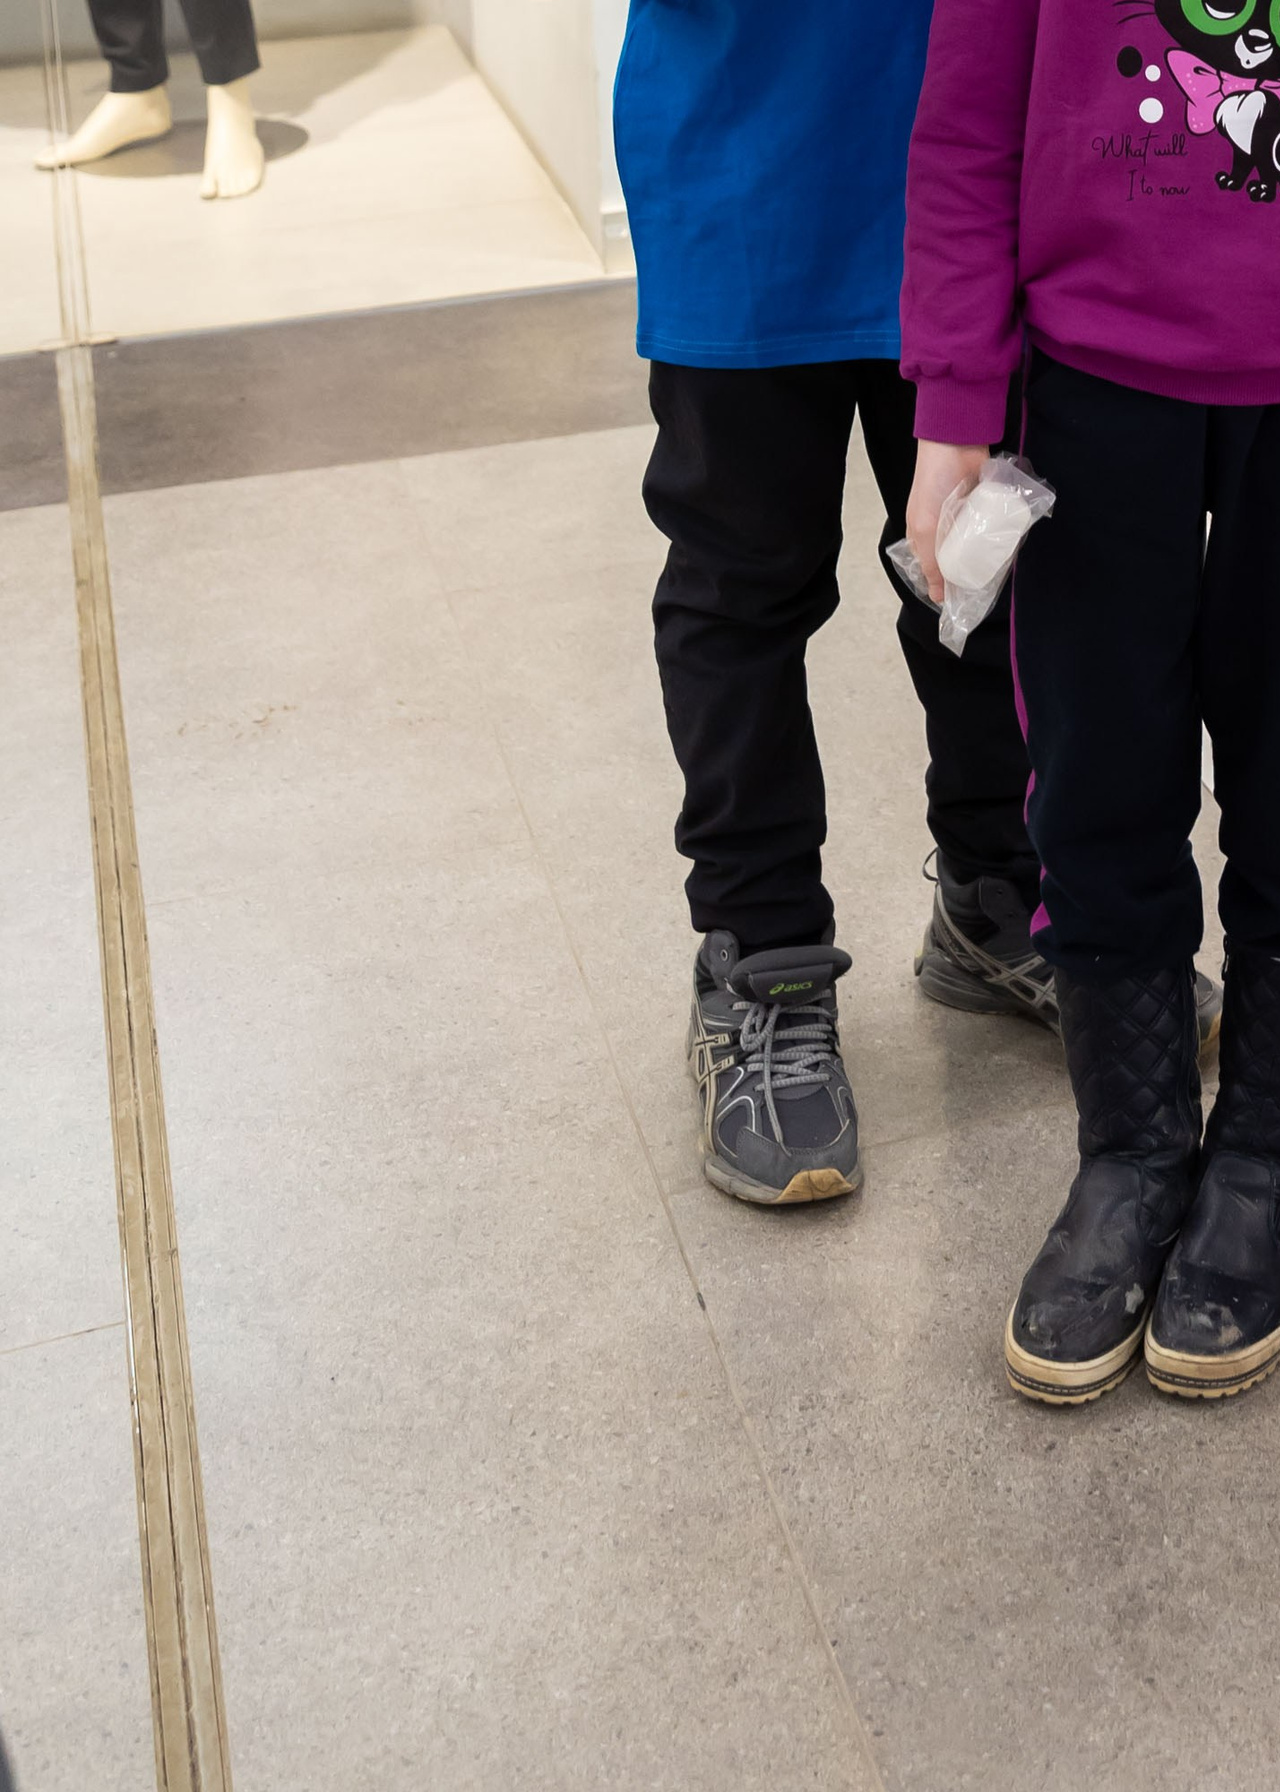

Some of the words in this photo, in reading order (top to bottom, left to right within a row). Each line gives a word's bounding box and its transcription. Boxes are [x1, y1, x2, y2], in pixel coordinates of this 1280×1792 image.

[1091, 129, 1160, 167] What
[1154, 132, 1189, 157] will
[1126, 169, 1138, 202] I
[1141, 174, 1154, 196] to
